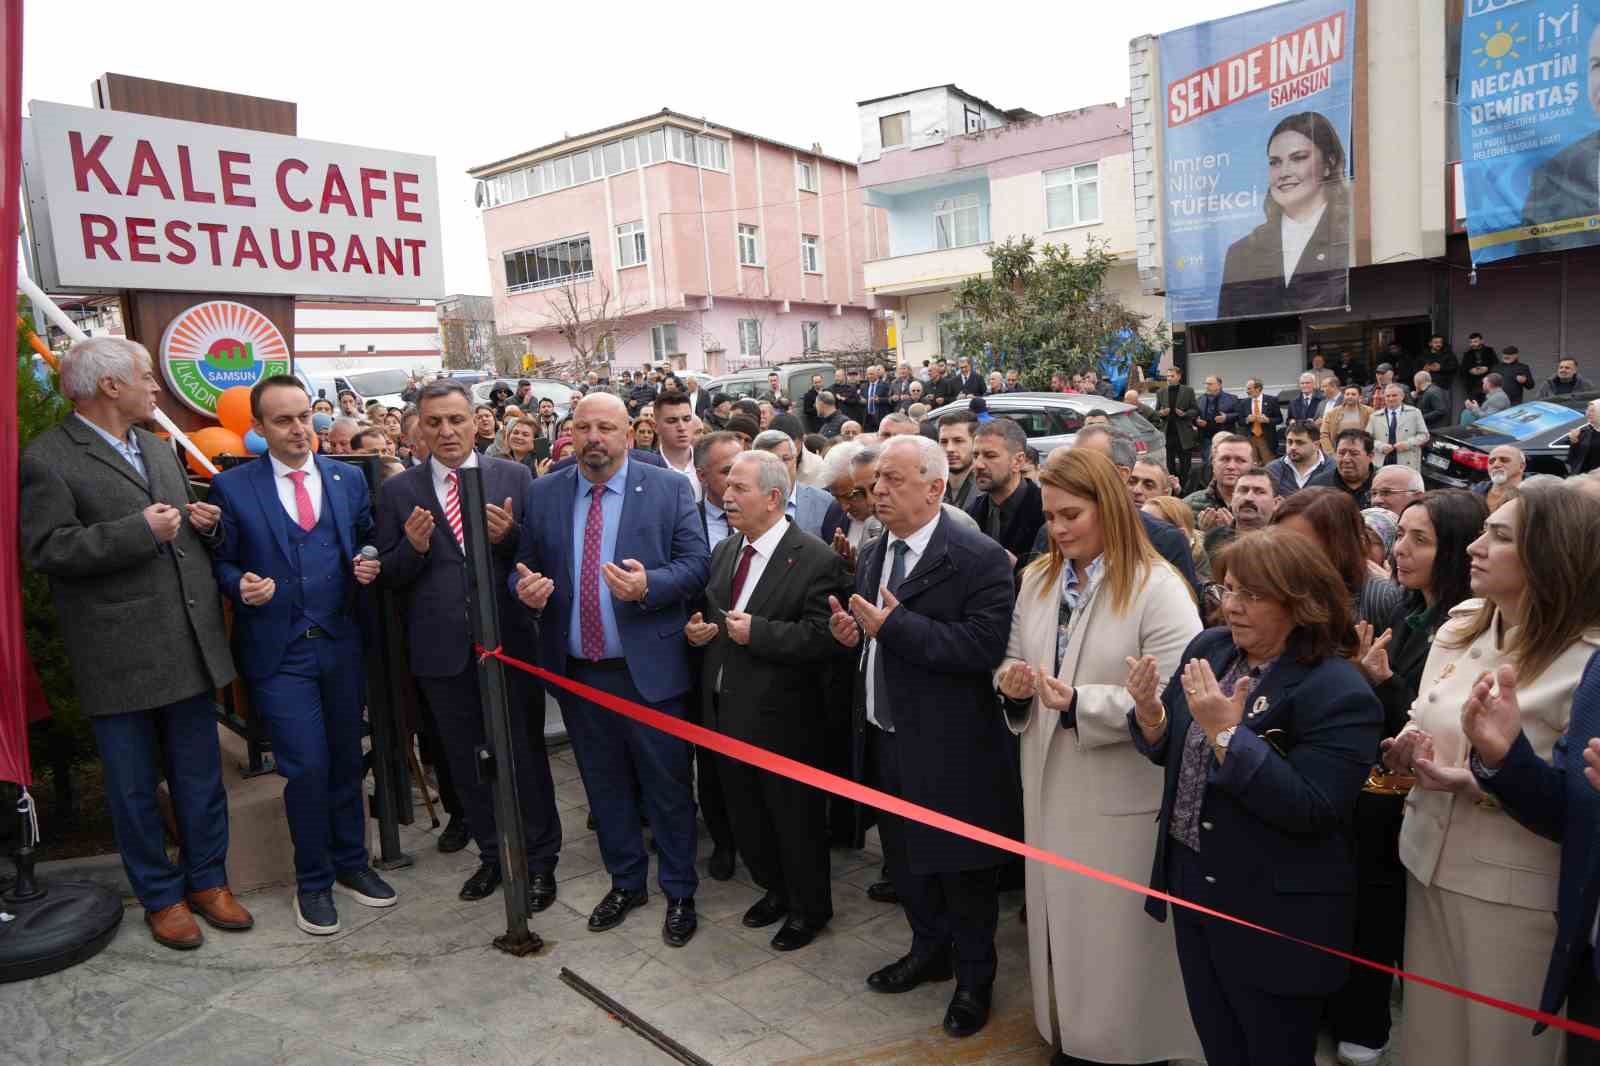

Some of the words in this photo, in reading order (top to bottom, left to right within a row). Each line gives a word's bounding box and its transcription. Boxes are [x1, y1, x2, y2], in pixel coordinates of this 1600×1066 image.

[1171, 67, 1220, 123] SEN
[1228, 50, 1264, 101] DE
[1269, 16, 1342, 84] İNAN
[1271, 70, 1329, 108] SAMSUN
[1471, 52, 1577, 99] NECATTİN
[1471, 81, 1579, 125] DEMİRTAŞ
[68, 130, 256, 208] KALE
[275, 157, 423, 223] CAFE
[1170, 171, 1221, 193] Nilay
[80, 213, 427, 277] RESTAURANT
[208, 371, 256, 381] SAMSUN
